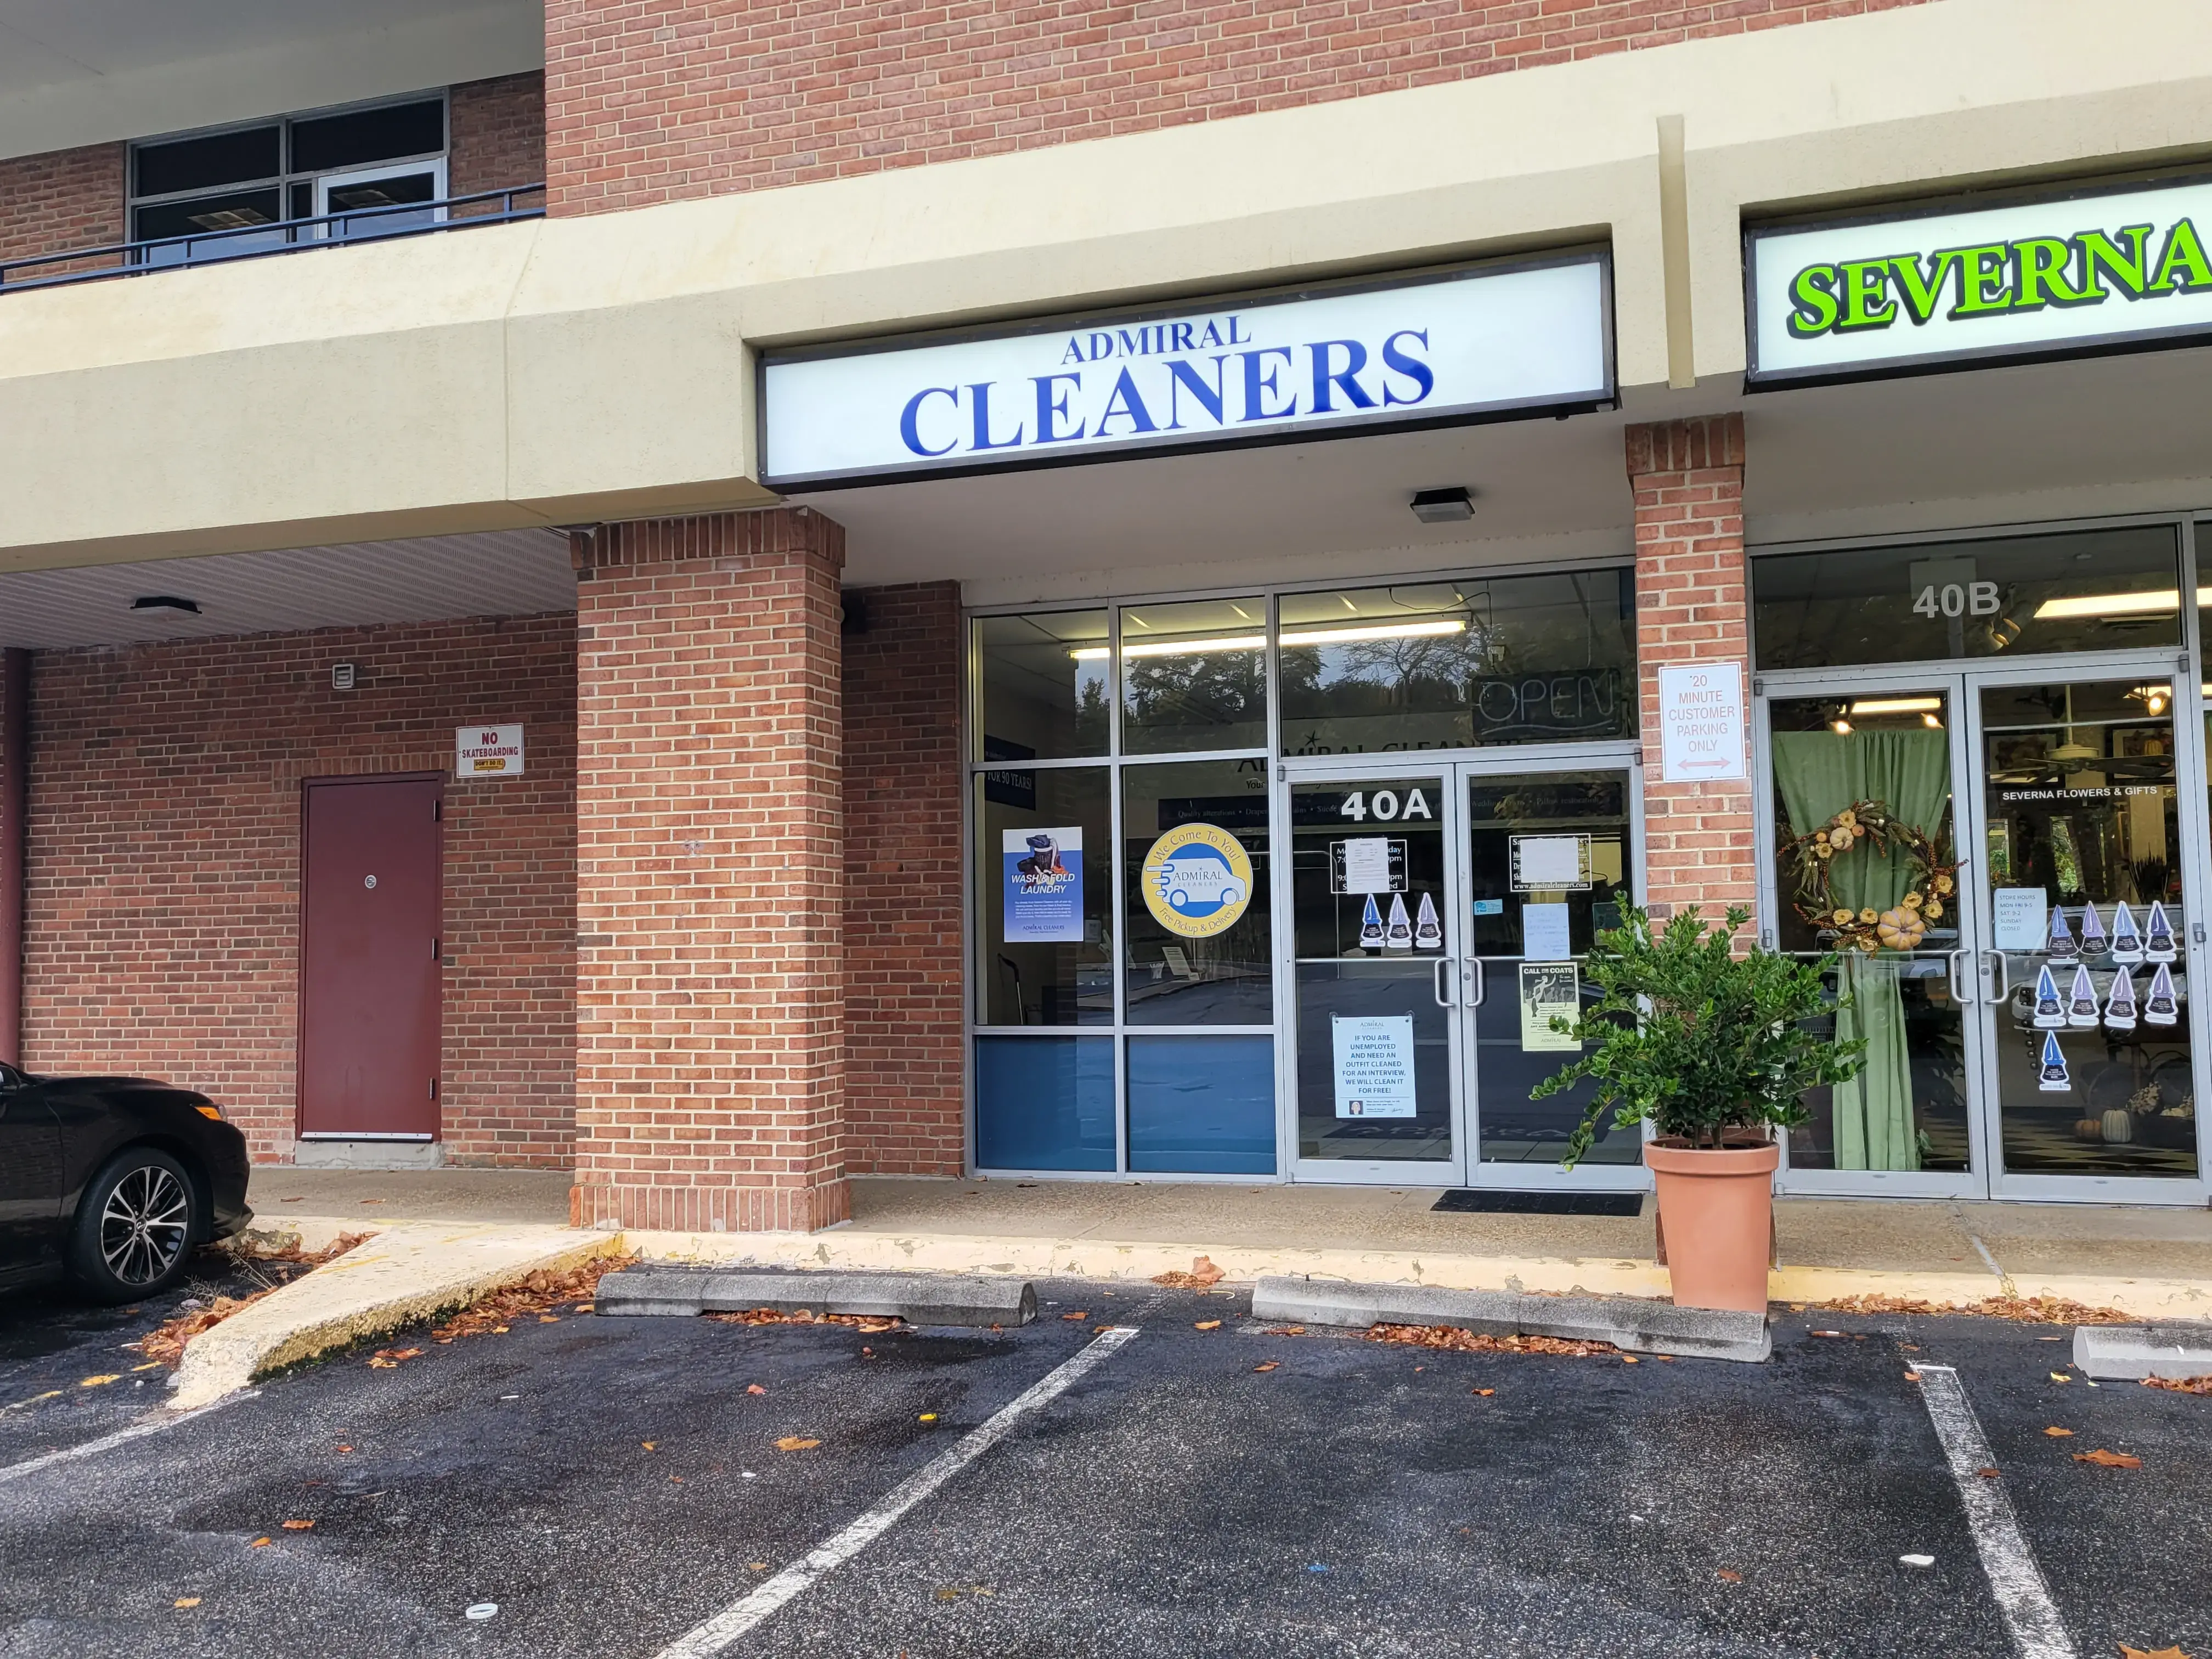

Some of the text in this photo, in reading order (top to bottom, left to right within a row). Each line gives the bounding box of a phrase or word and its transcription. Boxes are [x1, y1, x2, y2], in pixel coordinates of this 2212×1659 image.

[1786, 217, 2212, 339] SEVERNA
[1060, 315, 1251, 365] ADMIRAL
[900, 329, 1435, 456] CLEANERS
[1913, 582, 2001, 618] 40B
[1692, 675, 1707, 687] 20
[1479, 674, 1613, 721] OPEN
[1679, 690, 1723, 704] MINUTE
[1669, 706, 1735, 721] CUSTOMER
[1677, 723, 1728, 737] PARKING
[482, 732, 498, 745] NO
[462, 746, 518, 758] SKATEBOARDING
[1689, 740, 1718, 752] ONLY
[988, 771, 1001, 783] FOR
[1002, 771, 1010, 785] 90
[2002, 790, 2055, 800] SEVERNA
[2057, 788, 2111, 798] FLOWERS
[2125, 786, 2158, 795] GIFTS
[1341, 788, 1432, 821] 40A
[1178, 810, 1201, 819] Quality
[1154, 830, 1240, 861] We Come To You!
[1011, 873, 1075, 883] WASH & FOLD
[1173, 871, 1222, 881] ADMIRAL
[1020, 885, 1066, 894] LAUNDRY
[1159, 906, 1237, 935] Free Pickup & Delivery
